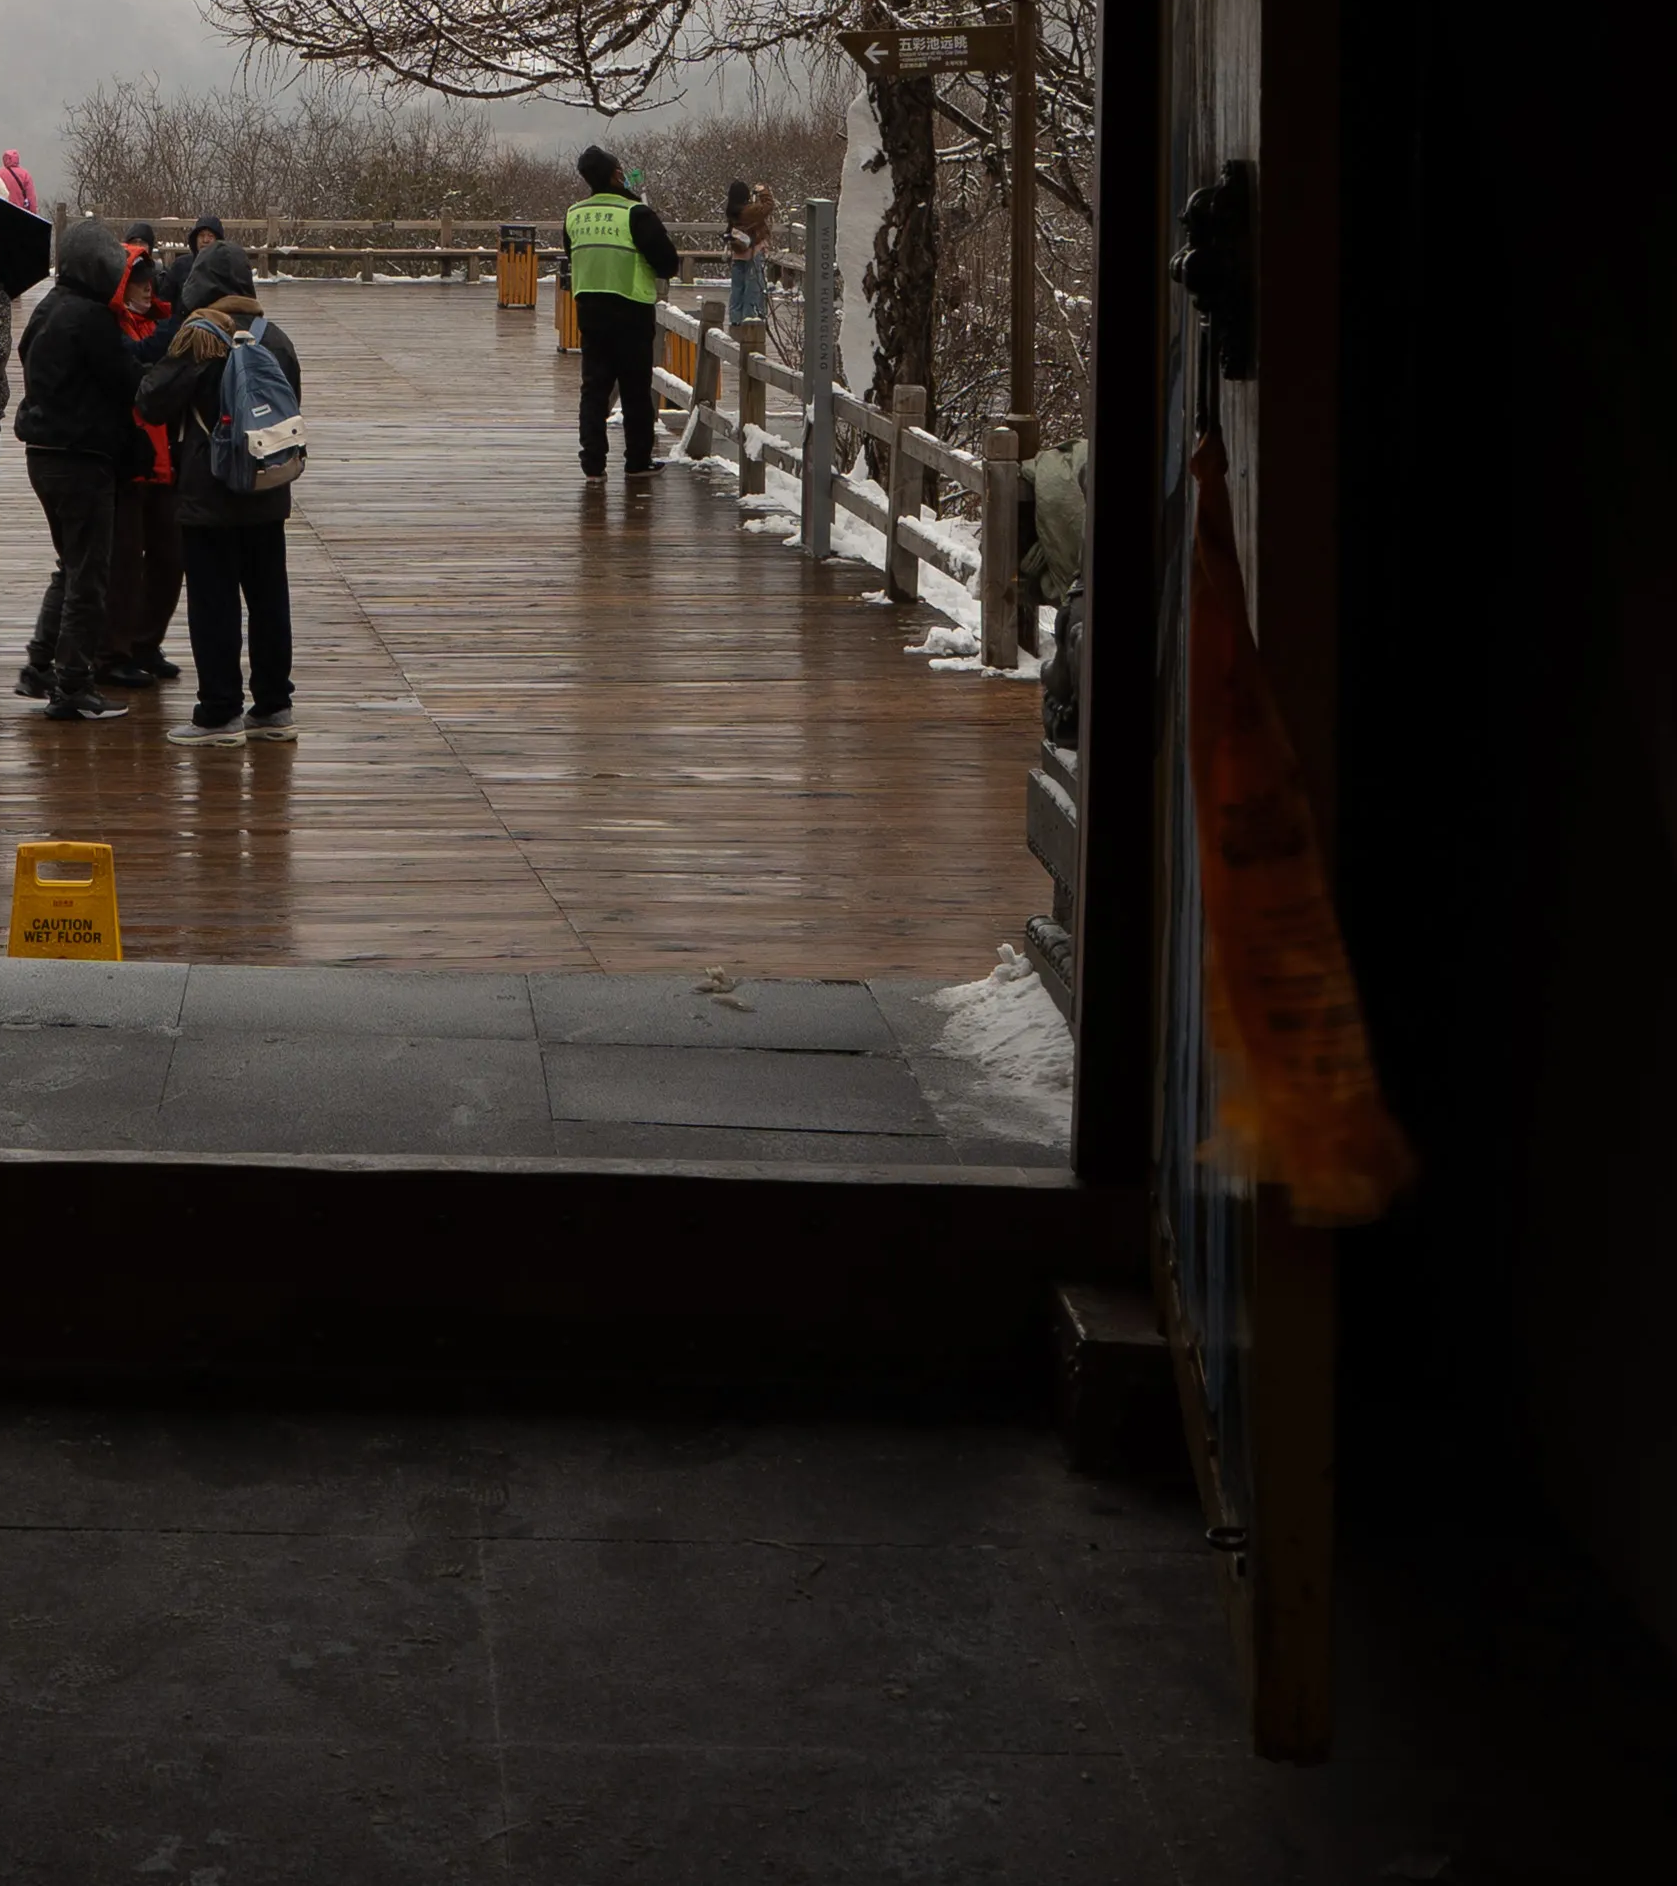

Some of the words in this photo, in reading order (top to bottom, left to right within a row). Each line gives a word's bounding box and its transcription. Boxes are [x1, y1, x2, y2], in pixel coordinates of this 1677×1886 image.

[898, 34, 968, 52] 五彩池远眺
[821, 226, 830, 281] WISDOM
[820, 287, 829, 371] HUANGLONG
[32, 918, 93, 931] CAUTION
[24, 931, 52, 943] WET
[57, 931, 102, 944] FLOOR
